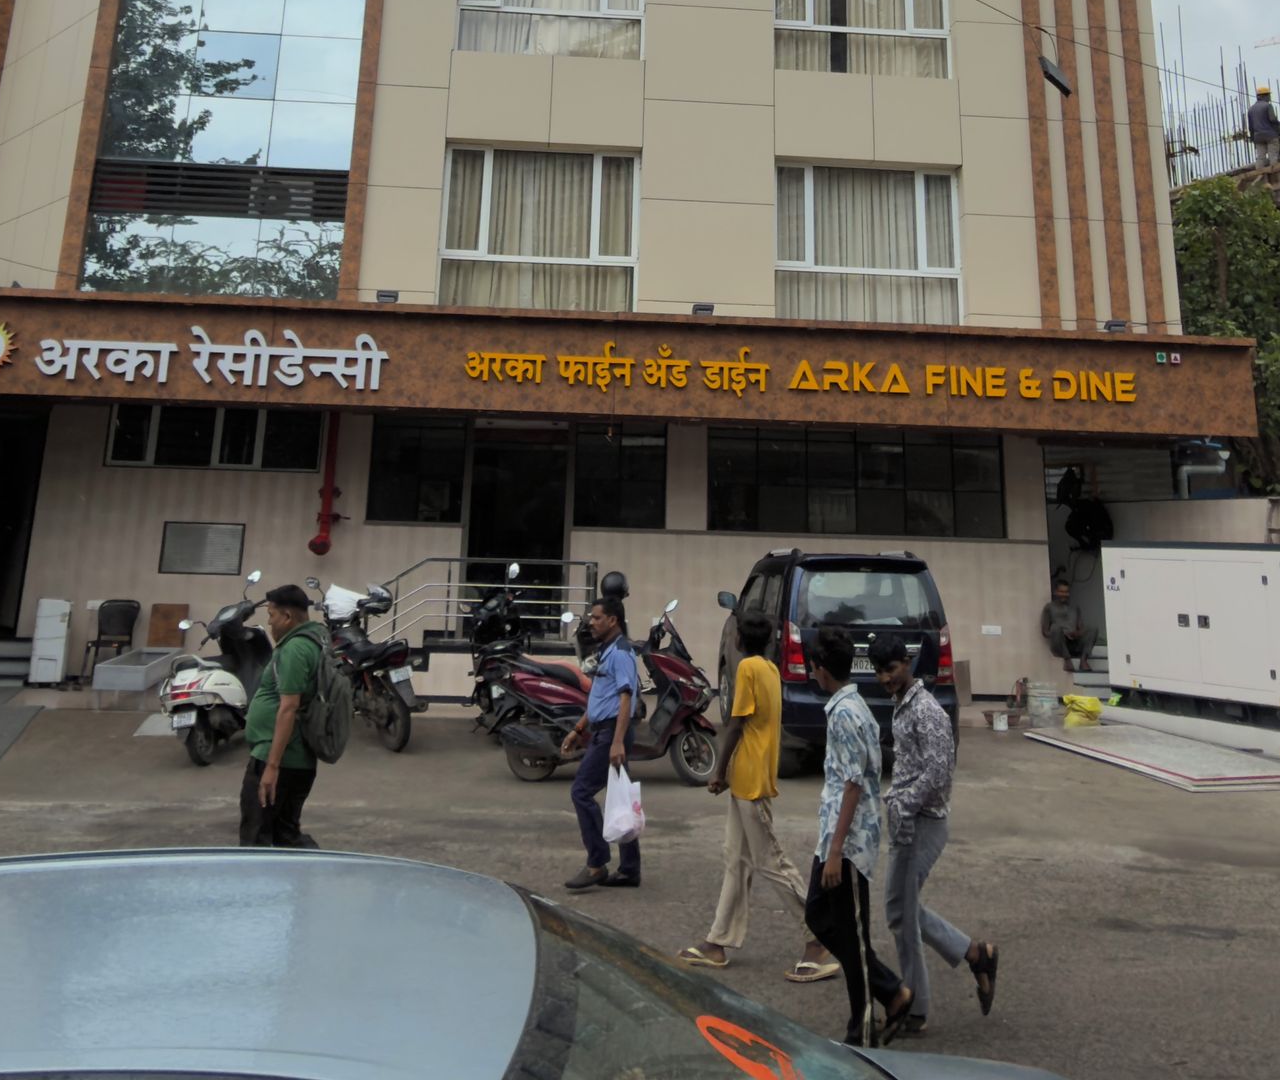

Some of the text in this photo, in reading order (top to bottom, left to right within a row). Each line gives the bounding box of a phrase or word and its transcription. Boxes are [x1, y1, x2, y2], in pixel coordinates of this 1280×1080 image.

[34, 325, 390, 391] अरका रेसीडेन्सी
[464, 341, 770, 398] अरका फाईन अँड डाईन
[788, 359, 1137, 403] ARKA FINE & DINE
